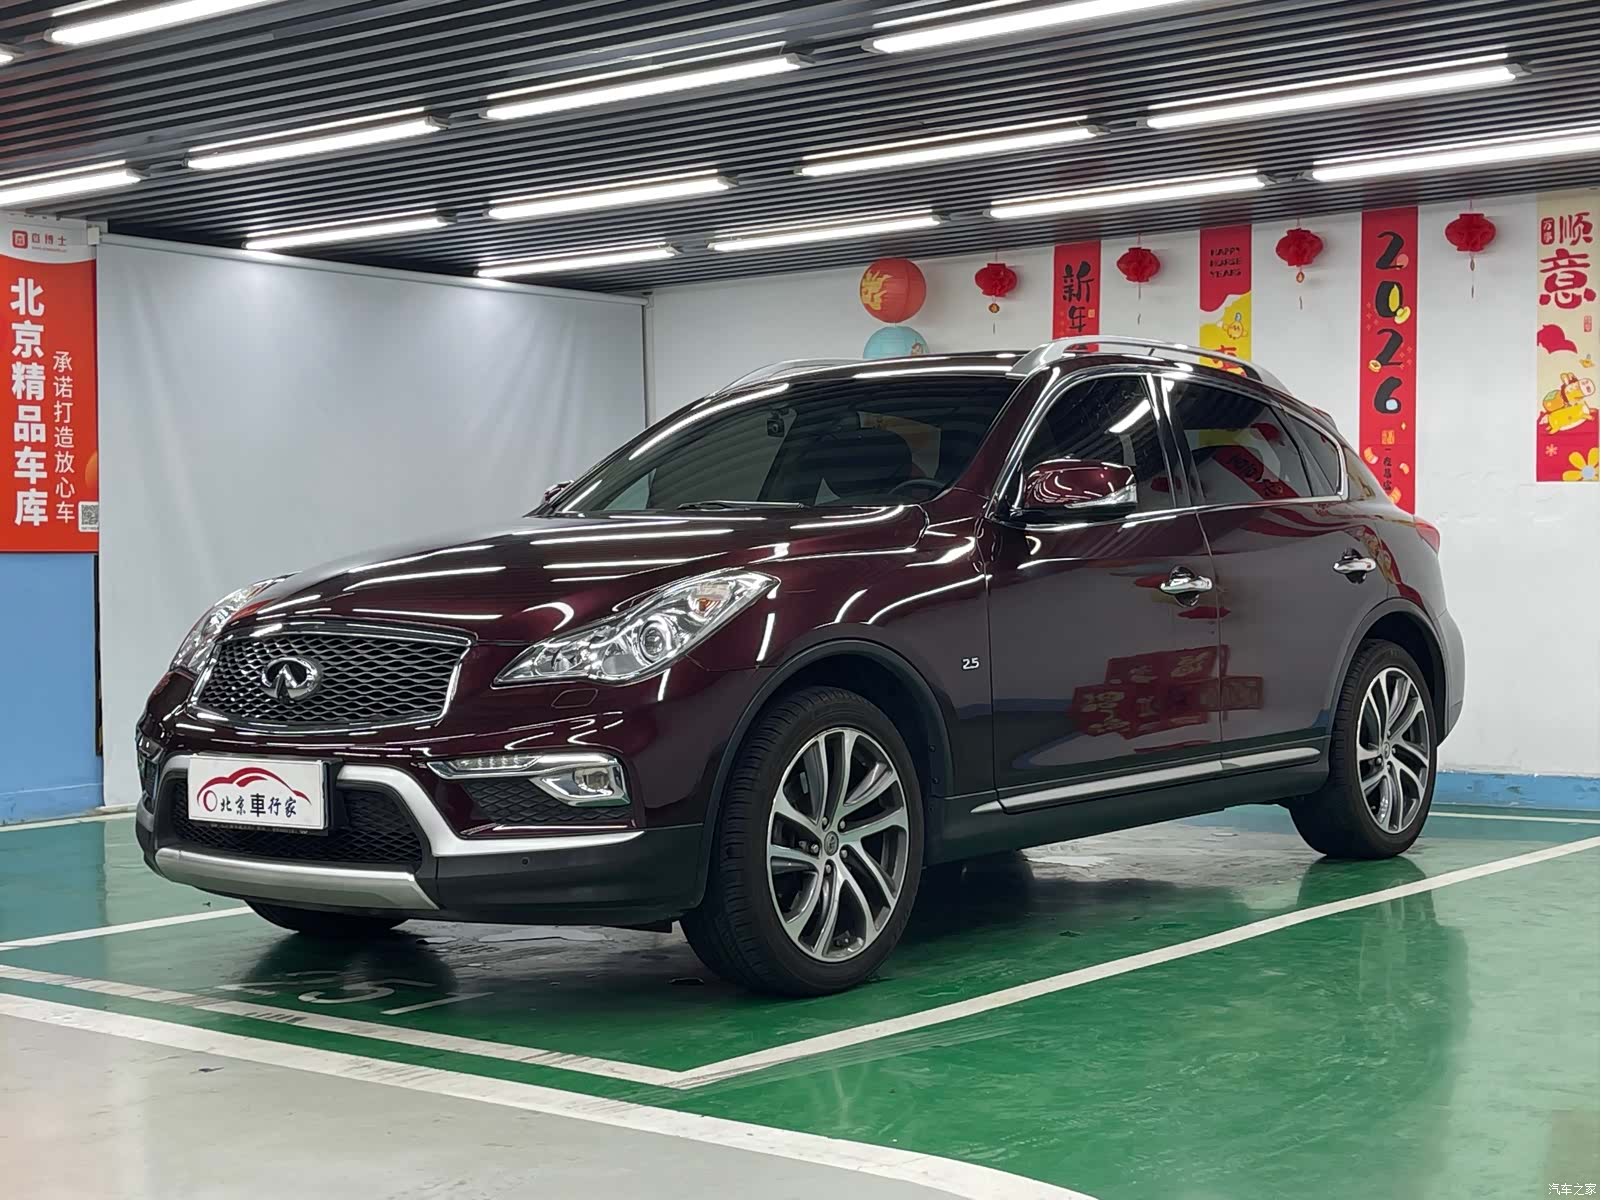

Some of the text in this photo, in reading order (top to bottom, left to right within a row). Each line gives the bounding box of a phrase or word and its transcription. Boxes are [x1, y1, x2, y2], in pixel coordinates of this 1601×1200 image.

[1210, 247, 1240, 257] HAPPY
[1210, 257, 1241, 267] HORSE
[1210, 268, 1241, 278] YEARS
[1539, 212, 1596, 309] 顺意
[1374, 231, 1404, 414] 2026
[10, 278, 48, 526] 北京精品车库
[53, 351, 75, 523] 承诺打造放心车
